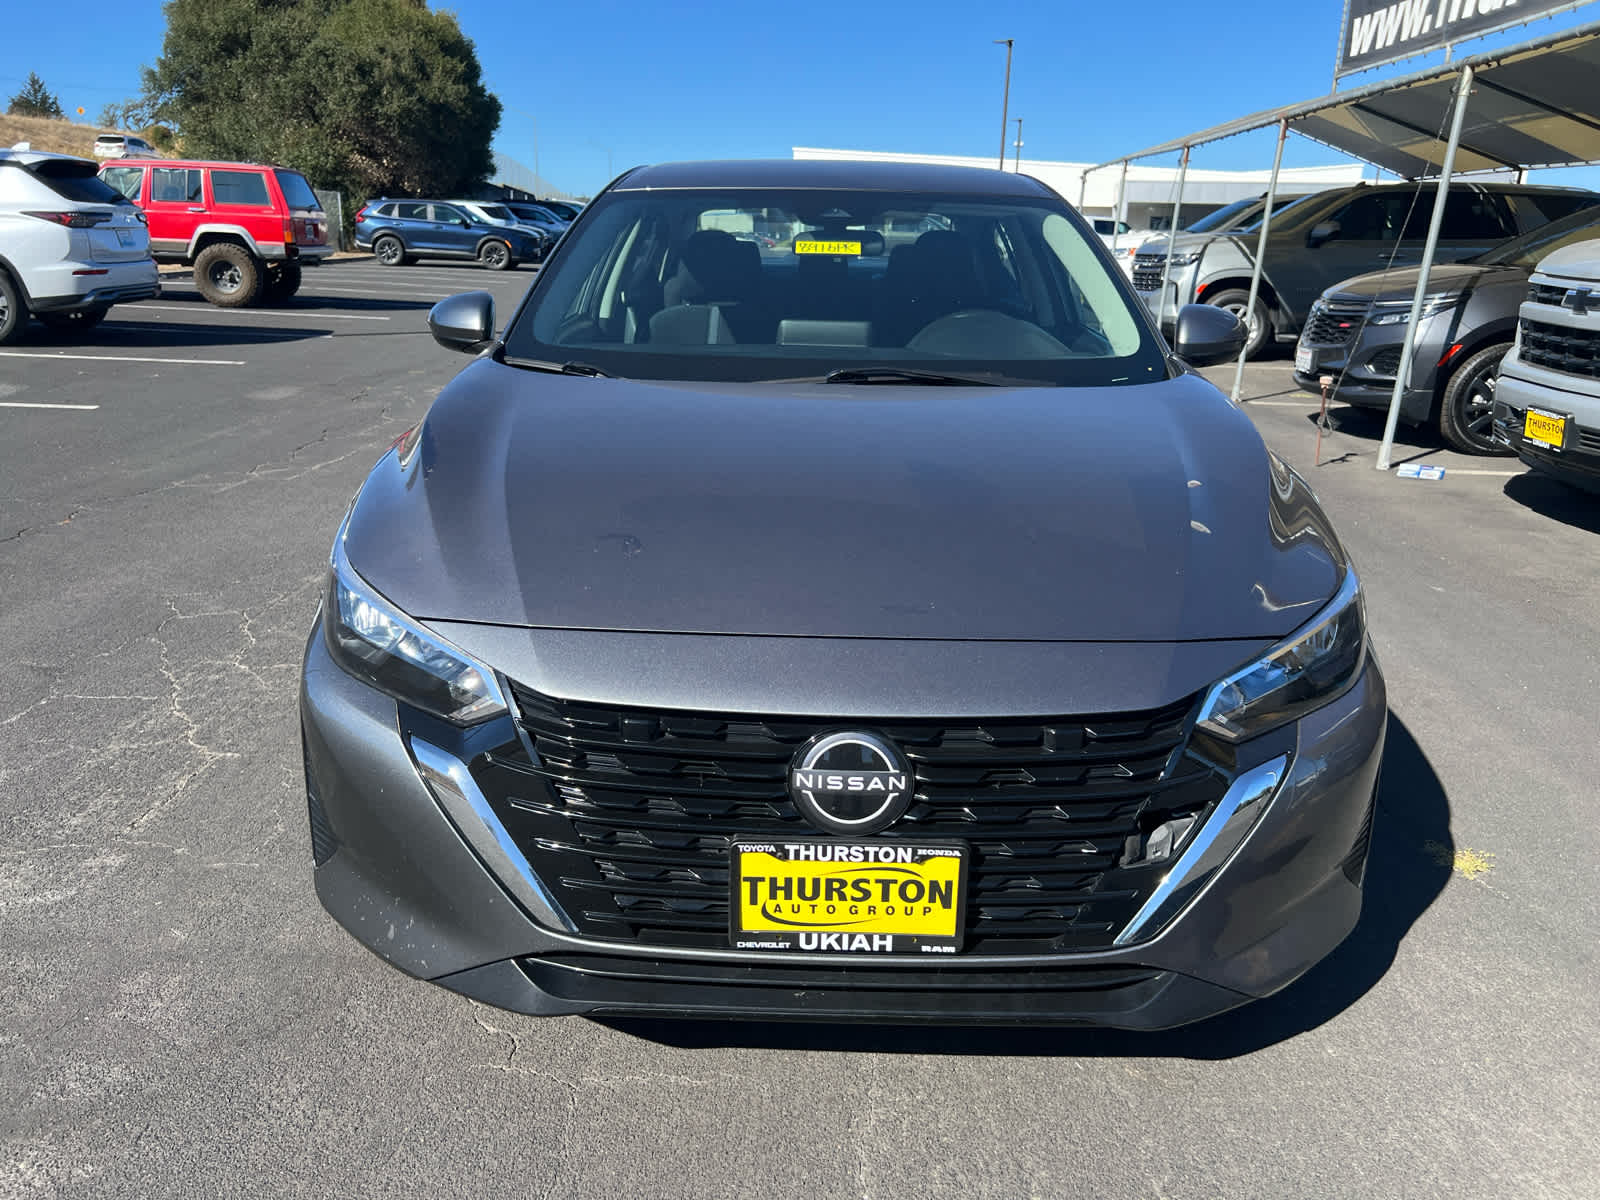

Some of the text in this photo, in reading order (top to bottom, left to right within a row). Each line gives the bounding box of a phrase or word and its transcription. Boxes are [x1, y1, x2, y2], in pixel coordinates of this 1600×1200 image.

[796, 772, 906, 791] NISSAN
[737, 844, 776, 853] TOYOTA
[784, 844, 912, 863] THURSTON
[916, 848, 962, 857] HONDA
[742, 876, 954, 910] THURSTON
[773, 903, 932, 916] AUTO GROUP
[736, 941, 791, 949] CHEVROLET
[799, 932, 893, 952] UKIAH
